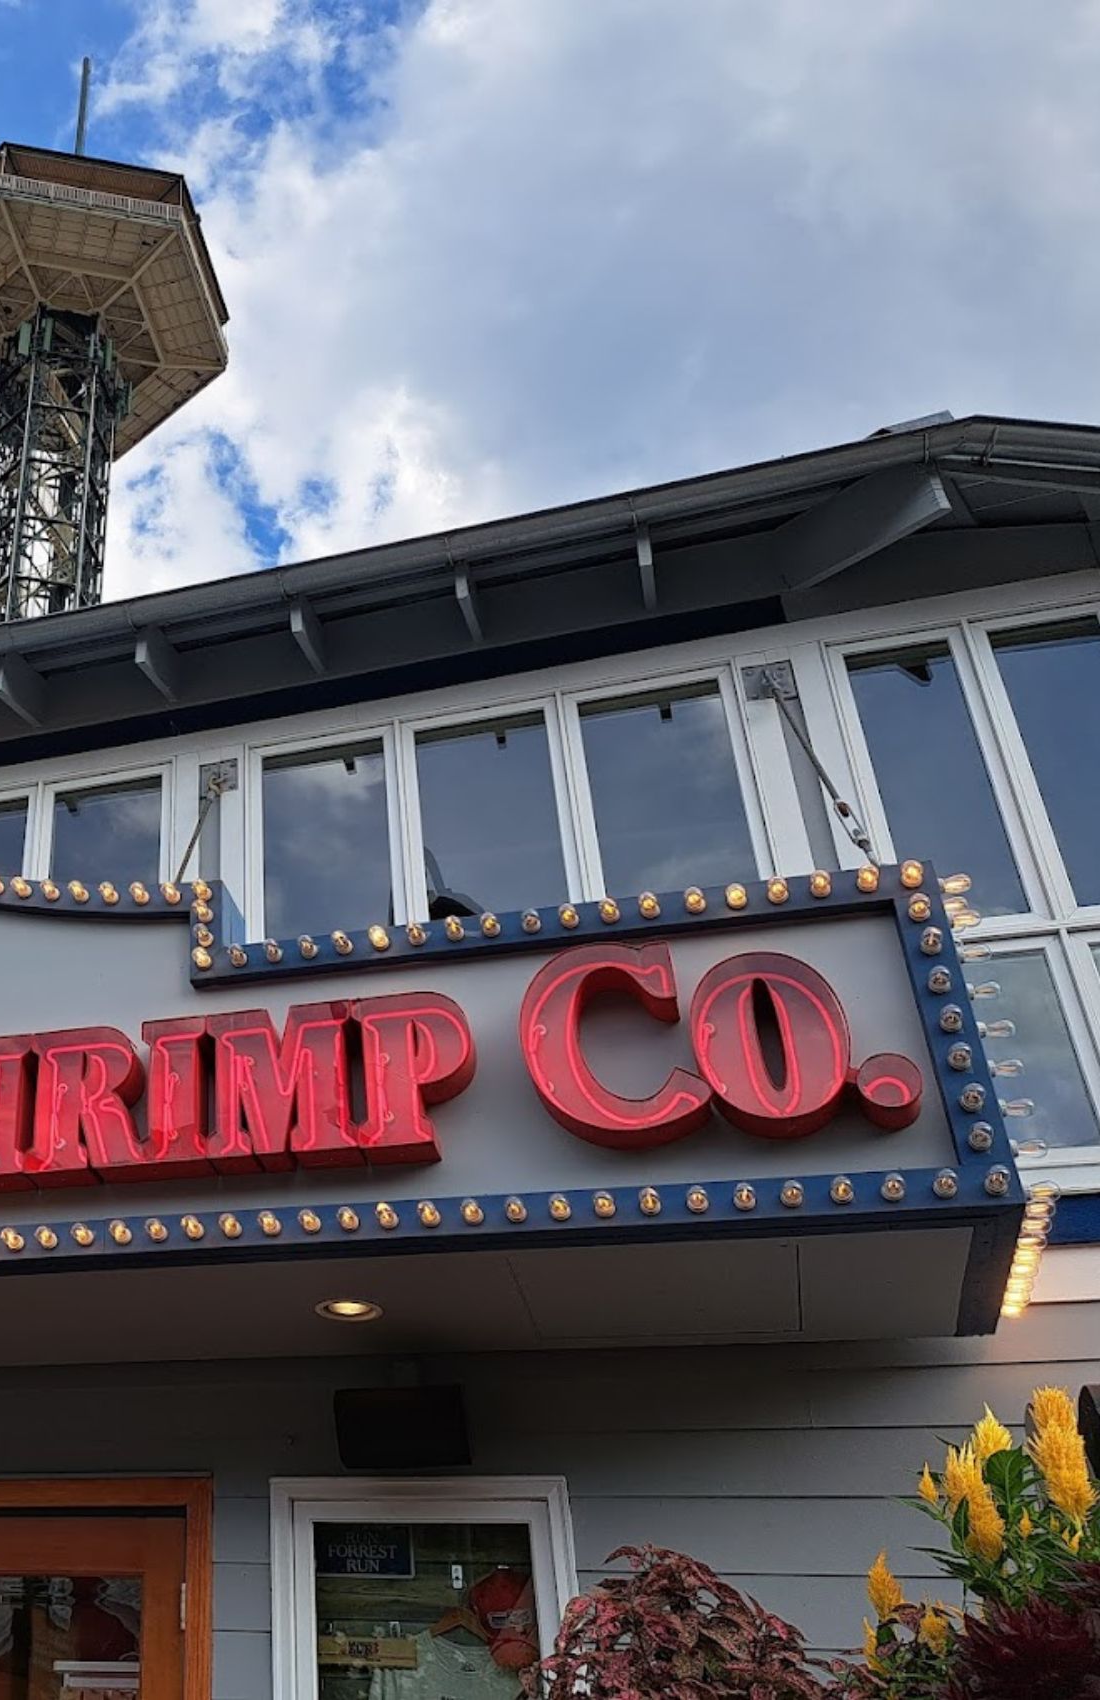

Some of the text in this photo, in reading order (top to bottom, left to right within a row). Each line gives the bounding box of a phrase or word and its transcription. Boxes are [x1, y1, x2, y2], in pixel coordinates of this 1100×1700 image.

[520, 941, 923, 1151] CO.
[327, 1544, 398, 1560] FORREST
[346, 1558, 381, 1573] RUN
